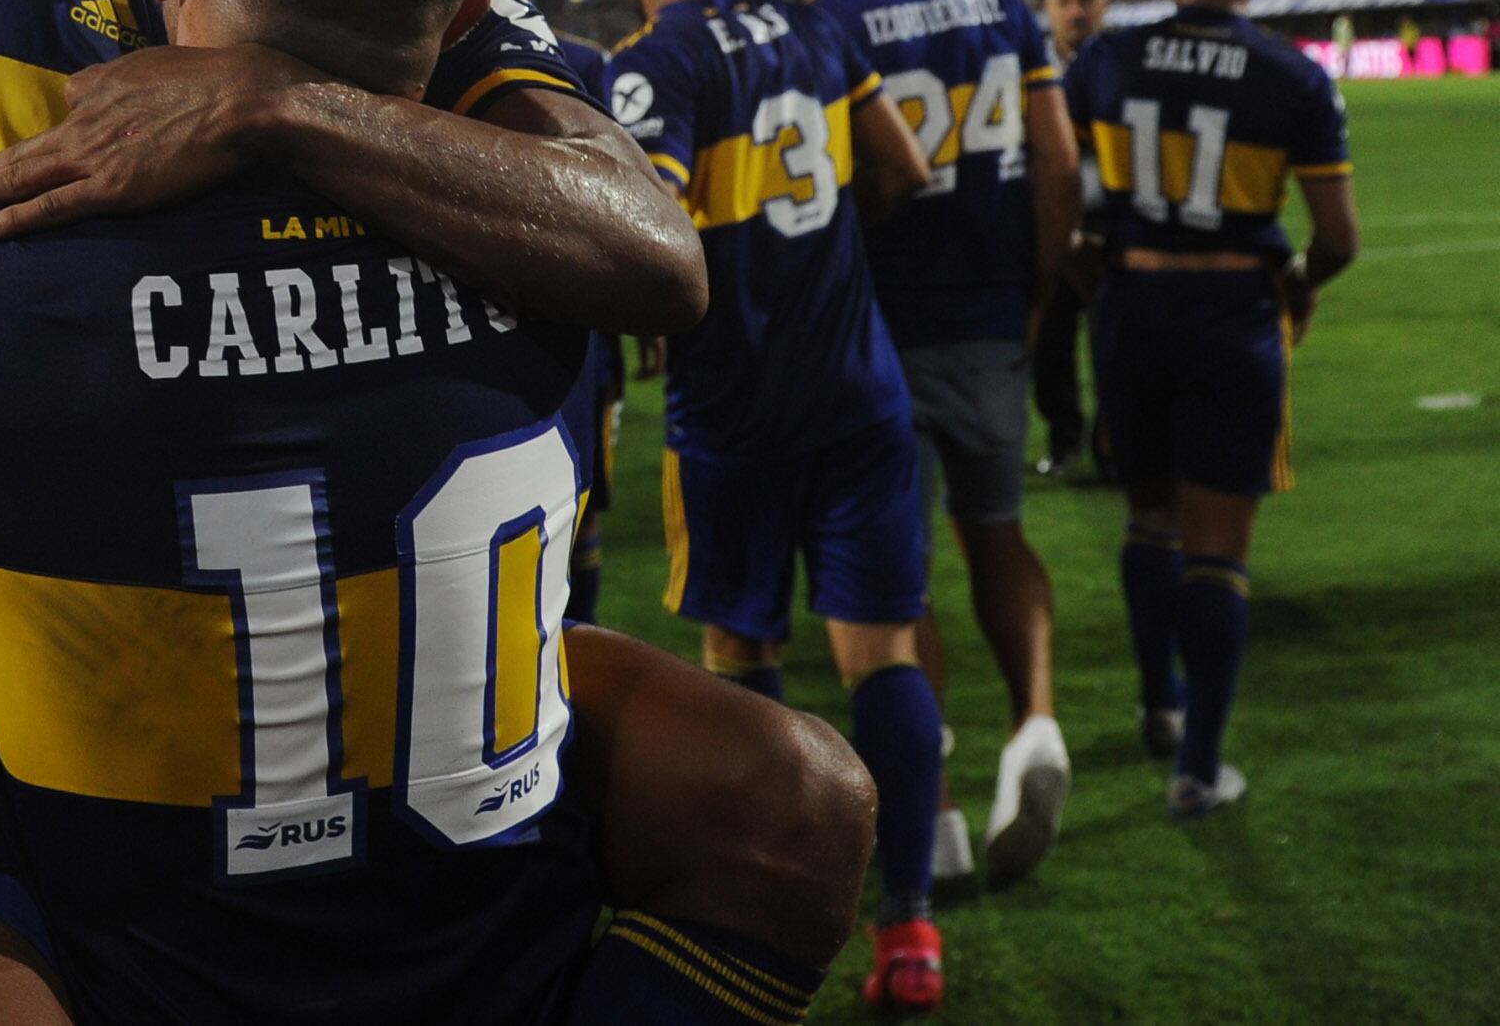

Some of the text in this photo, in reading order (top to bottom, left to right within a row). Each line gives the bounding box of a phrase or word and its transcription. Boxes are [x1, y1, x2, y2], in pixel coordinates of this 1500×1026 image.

[70, 6, 149, 48] adidas
[1143, 35, 1248, 80] SALVIO
[883, 52, 1024, 198] 24
[753, 88, 838, 238] 3
[1122, 98, 1230, 232] 11
[261, 216, 307, 239] LA
[187, 421, 583, 878] 10
[510, 761, 541, 804] RUS
[281, 815, 347, 847] RUS
